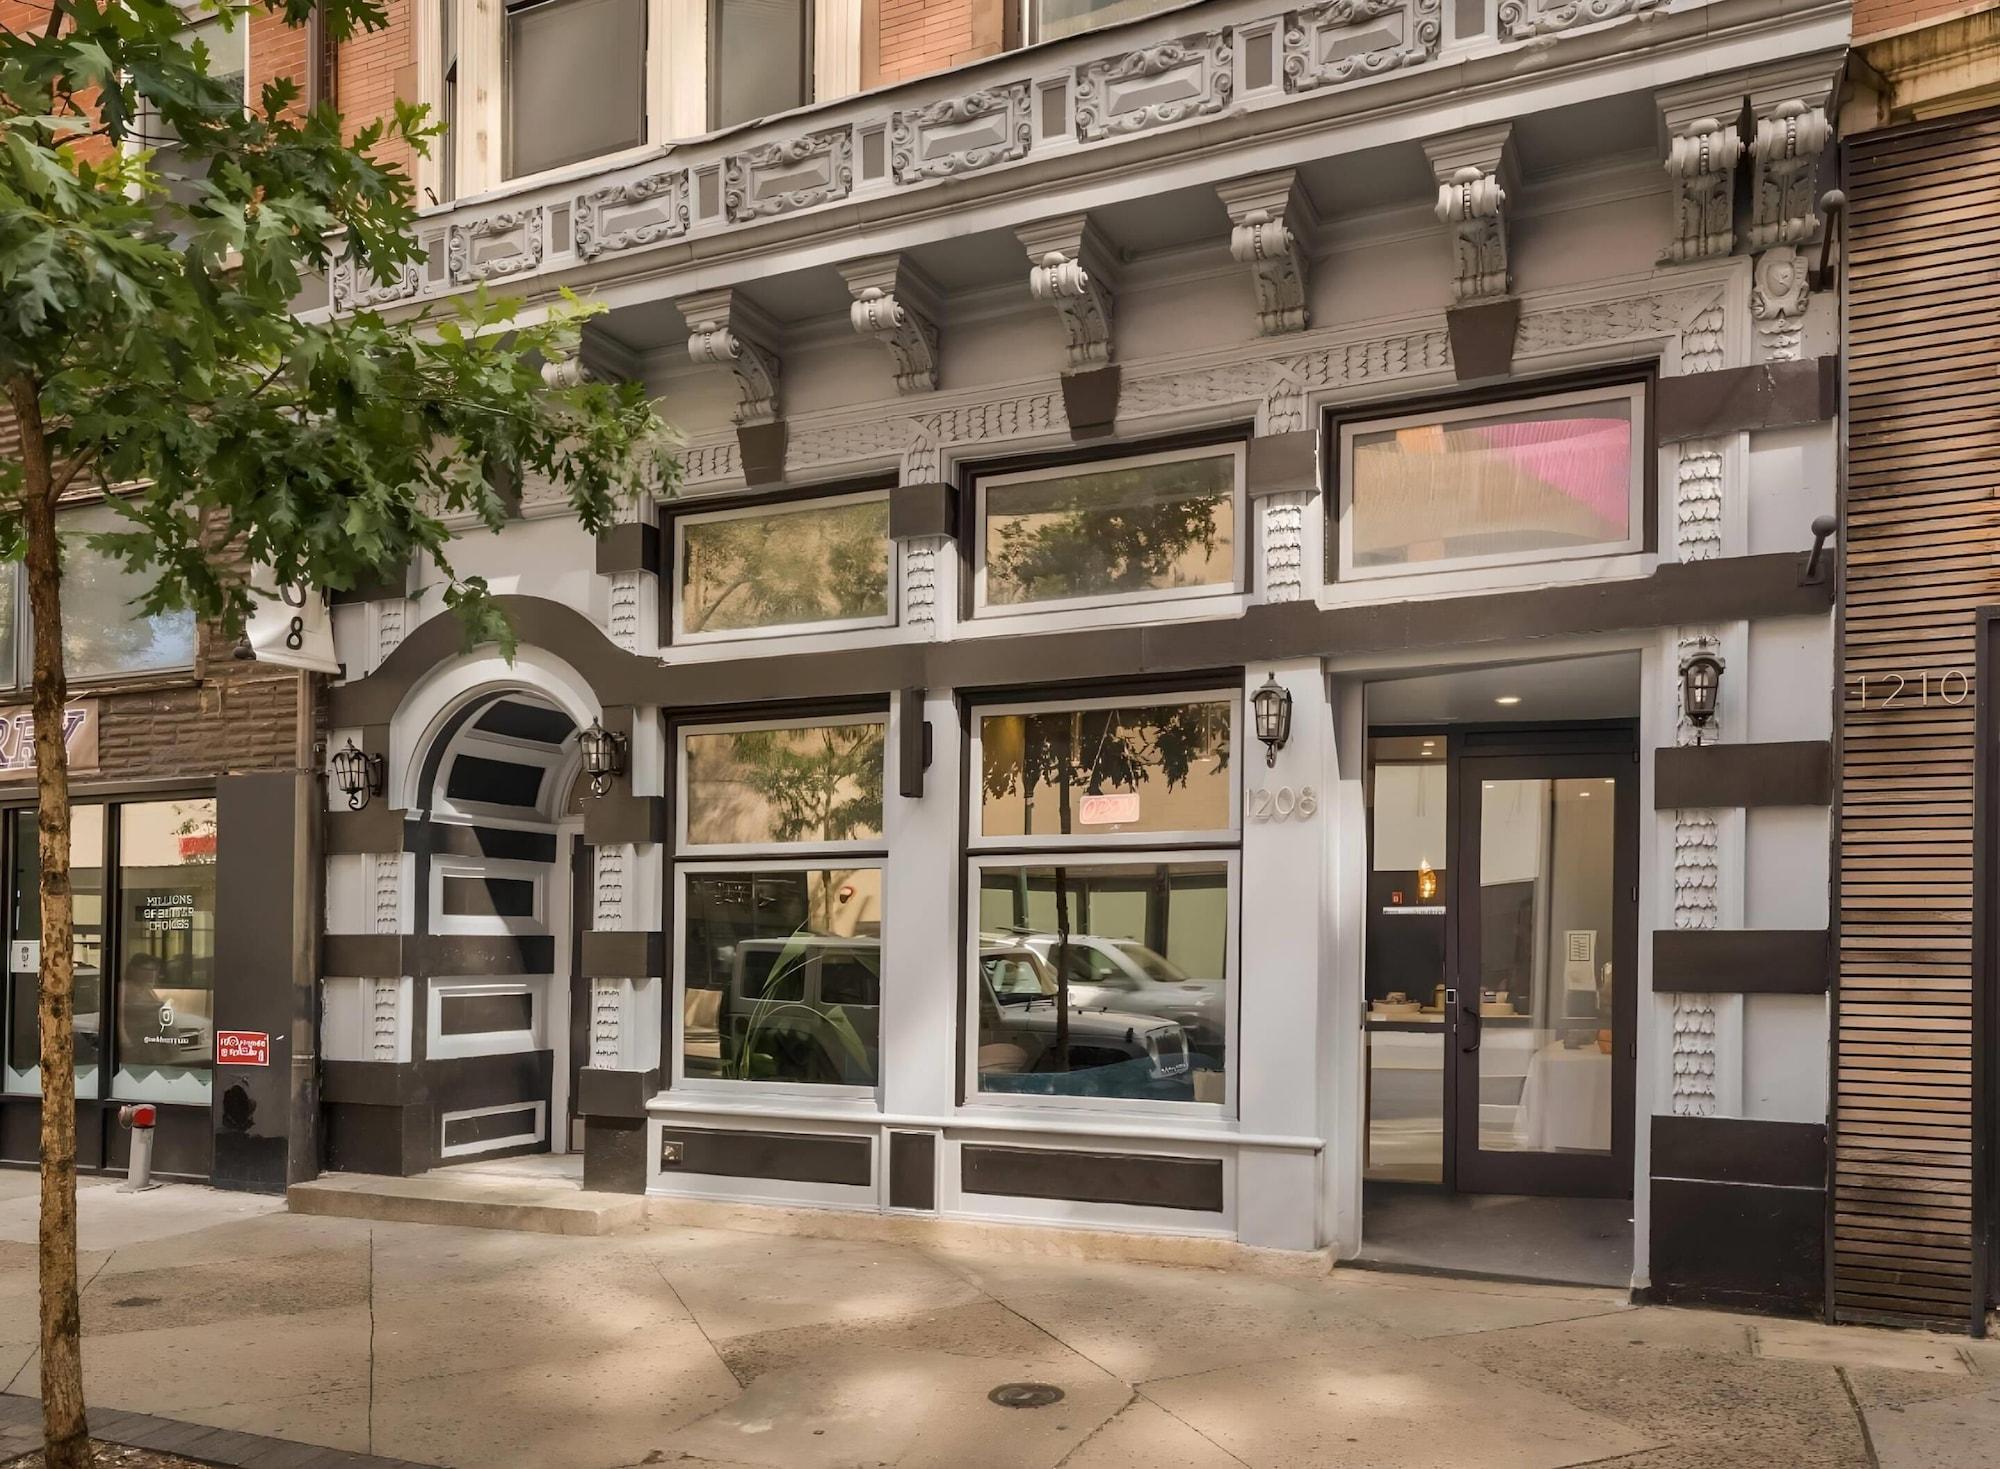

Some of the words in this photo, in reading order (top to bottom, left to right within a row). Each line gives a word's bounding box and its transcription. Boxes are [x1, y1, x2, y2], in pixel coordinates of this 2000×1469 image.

[1850, 670, 1968, 708] 1210
[1245, 786, 1319, 818] 1208
[146, 895, 193, 906] MILLIONS
